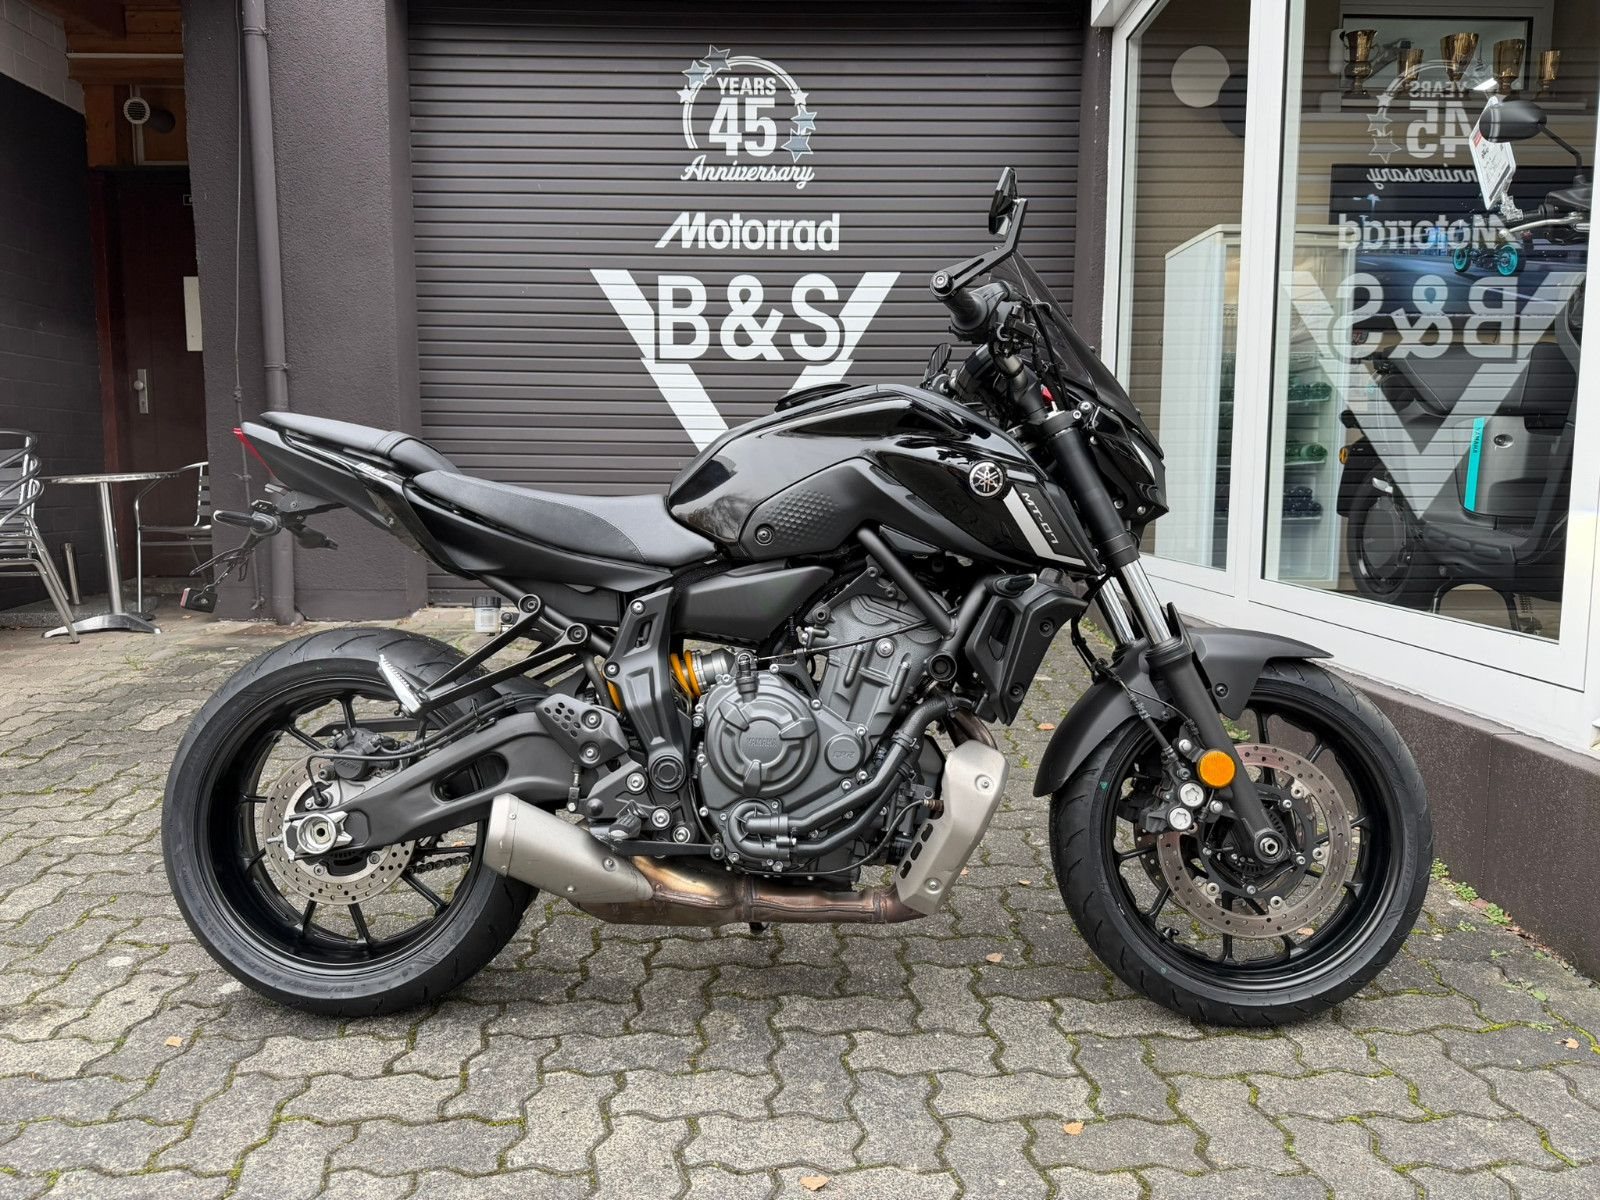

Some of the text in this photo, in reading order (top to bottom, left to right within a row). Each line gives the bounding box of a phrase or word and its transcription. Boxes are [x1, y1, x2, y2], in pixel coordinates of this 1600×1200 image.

[716, 77, 777, 96] YEARS
[708, 97, 777, 157] 45
[680, 154, 815, 190] Anniversary
[654, 211, 840, 251] Motorrad
[1021, 492, 1059, 544] MT-07
